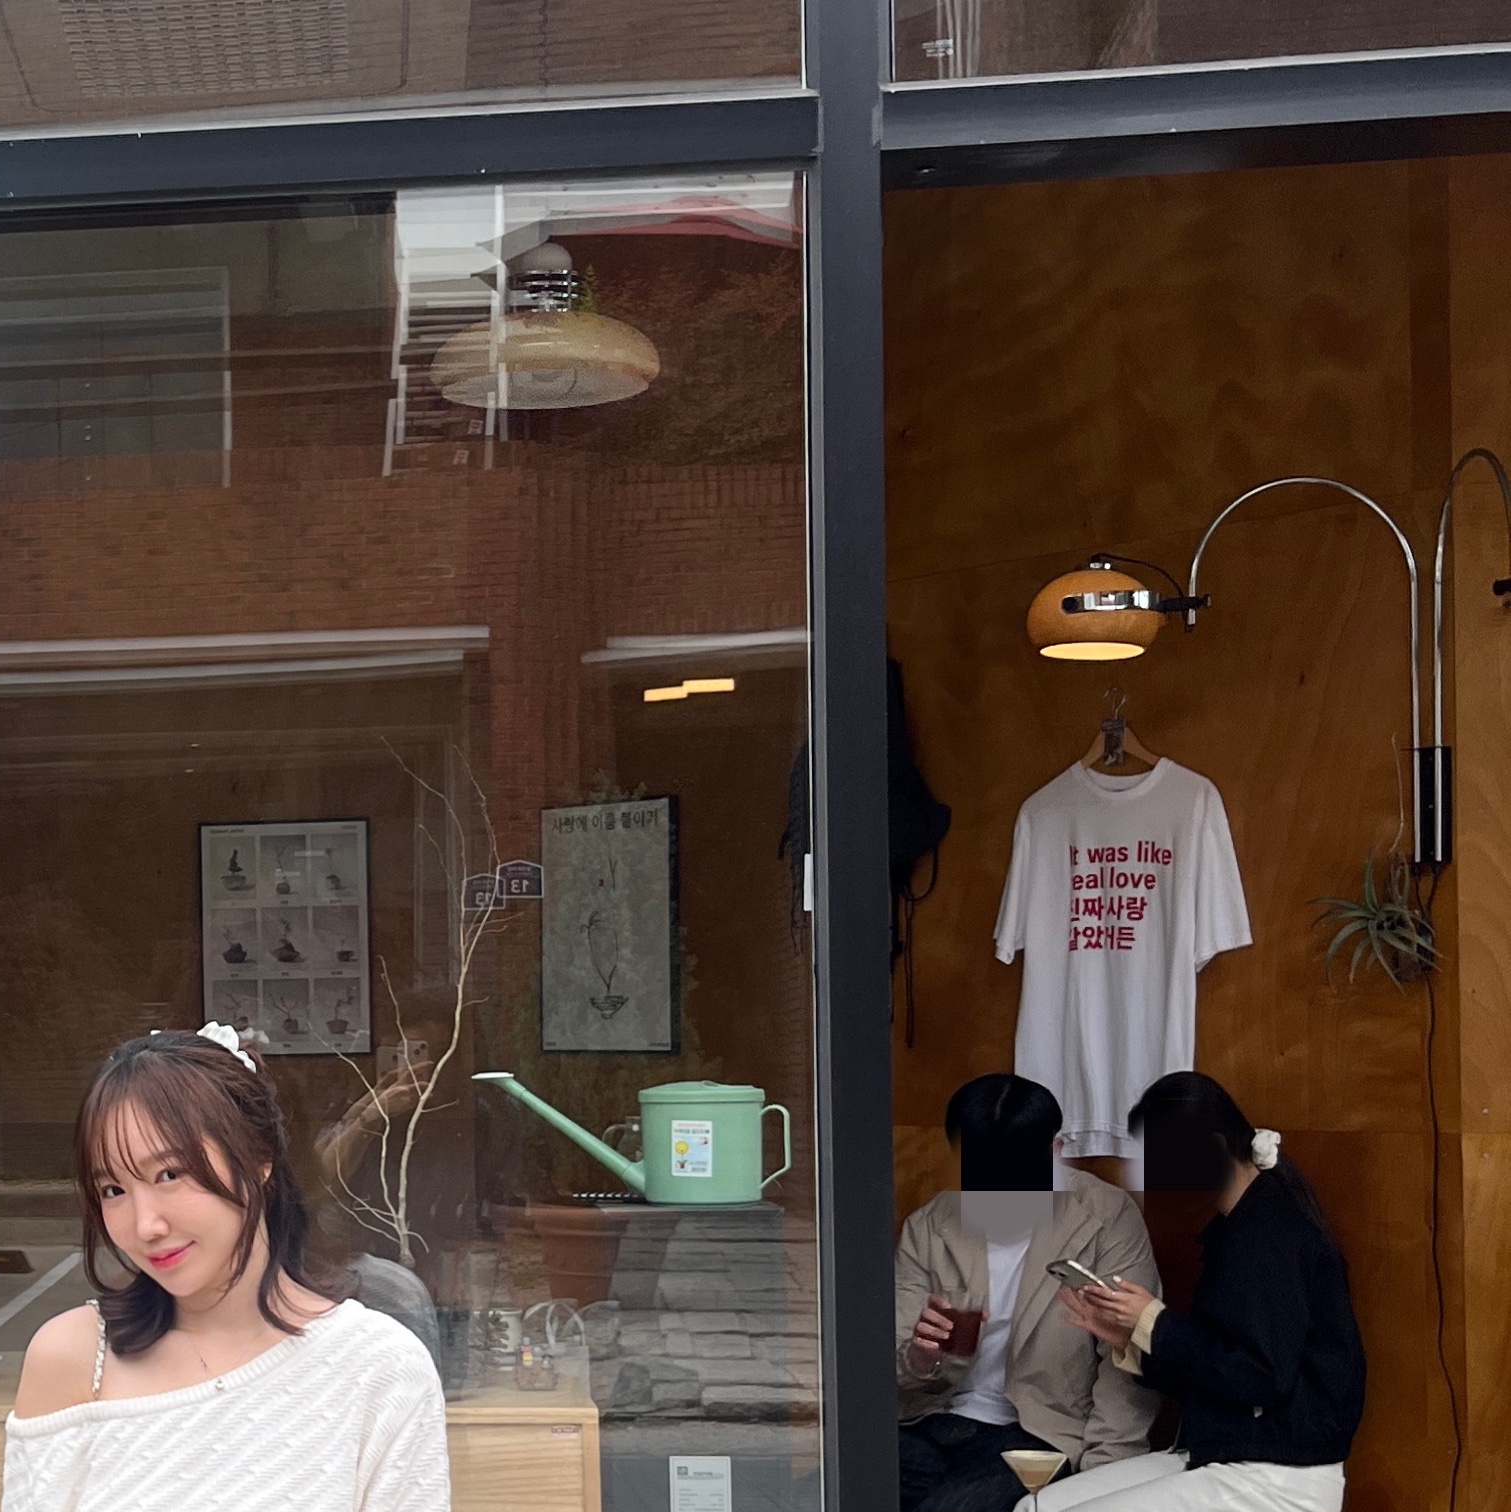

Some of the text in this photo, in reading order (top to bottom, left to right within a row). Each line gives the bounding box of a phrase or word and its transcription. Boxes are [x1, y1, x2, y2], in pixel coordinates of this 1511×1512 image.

[551, 808, 658, 834] 사랑에 이름 붙이기
[1087, 846, 1129, 864] was
[1136, 840, 1172, 866] like
[1071, 866, 1156, 891] eal love
[1106, 895, 1148, 921] 사랑
